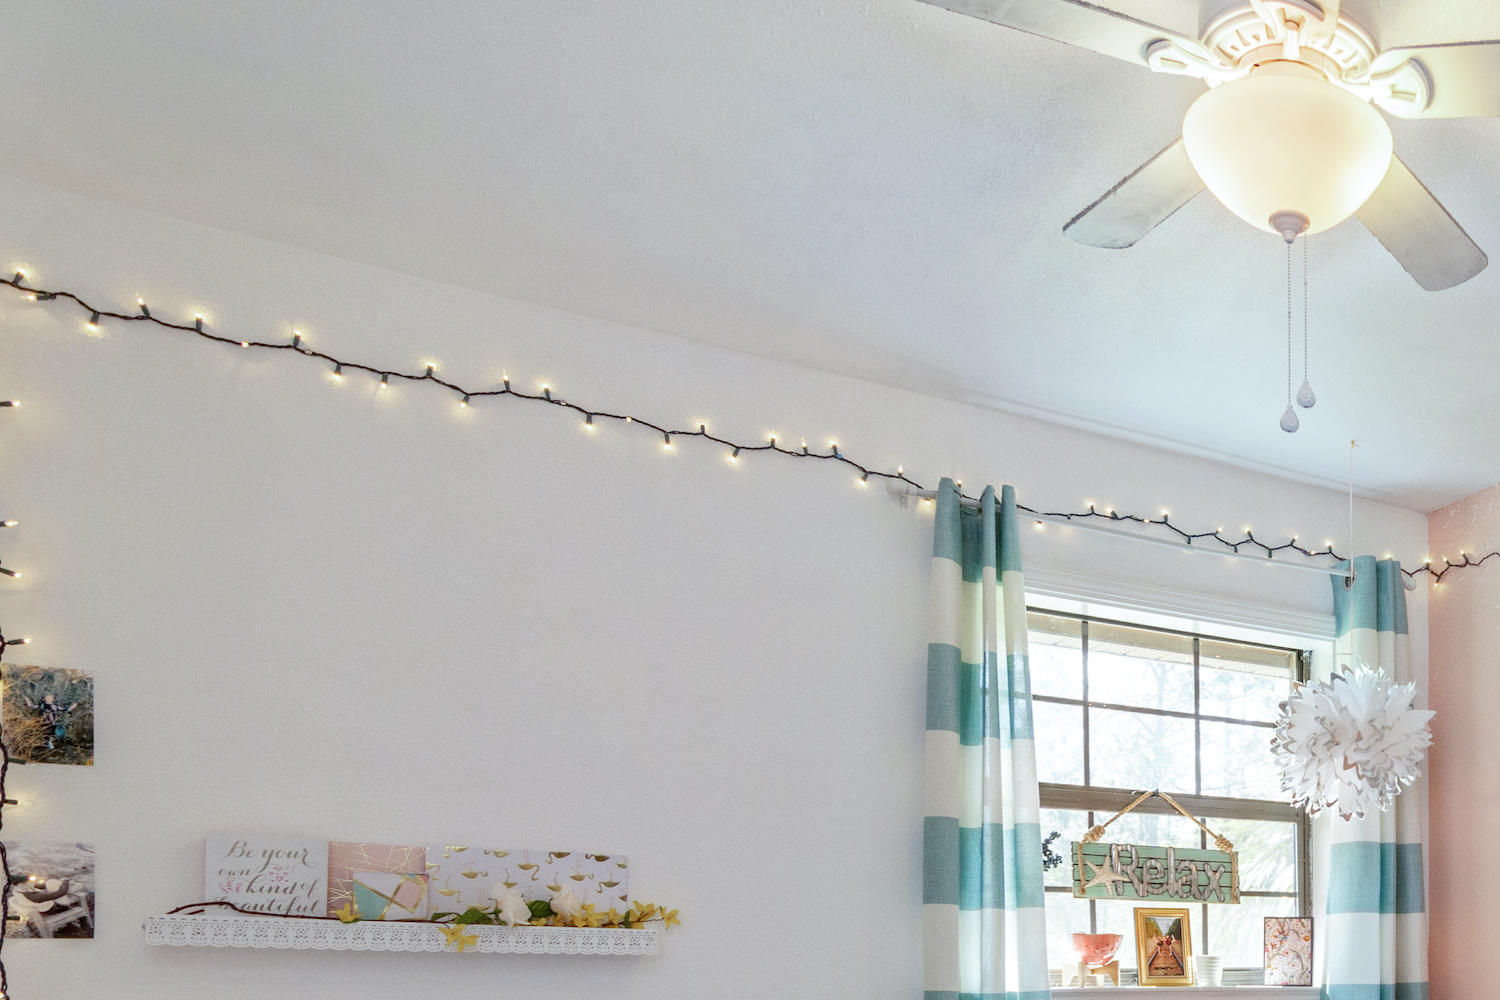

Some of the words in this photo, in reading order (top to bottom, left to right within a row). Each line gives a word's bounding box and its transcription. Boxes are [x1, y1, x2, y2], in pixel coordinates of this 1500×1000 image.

[226, 840, 256, 858] Be
[259, 848, 319, 873] your
[1110, 843, 1226, 902] Relax
[246, 874, 297, 894] kind
[301, 879, 319, 898] of
